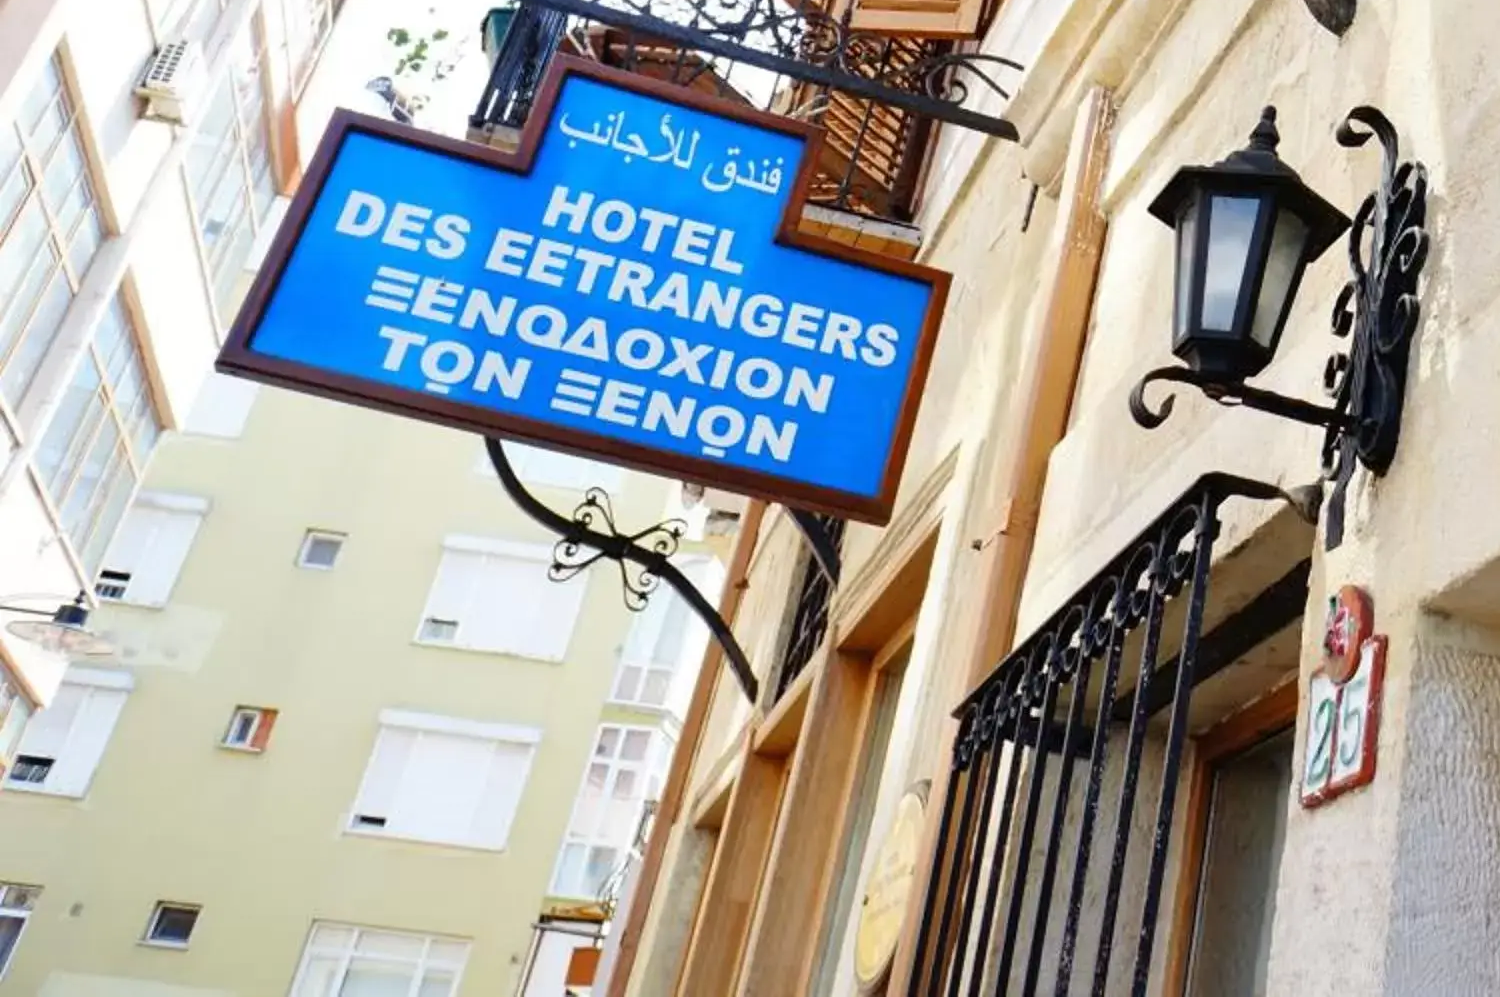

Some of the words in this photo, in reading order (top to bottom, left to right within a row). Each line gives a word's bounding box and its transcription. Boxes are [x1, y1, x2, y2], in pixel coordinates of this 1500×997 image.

[558, 110, 701, 170] للأجانب
[702, 146, 784, 195] فندق
[541, 186, 745, 274] HOTEL
[335, 190, 471, 260] DES
[484, 227, 899, 367] EETRANGERS
[1306, 678, 1364, 787] 25
